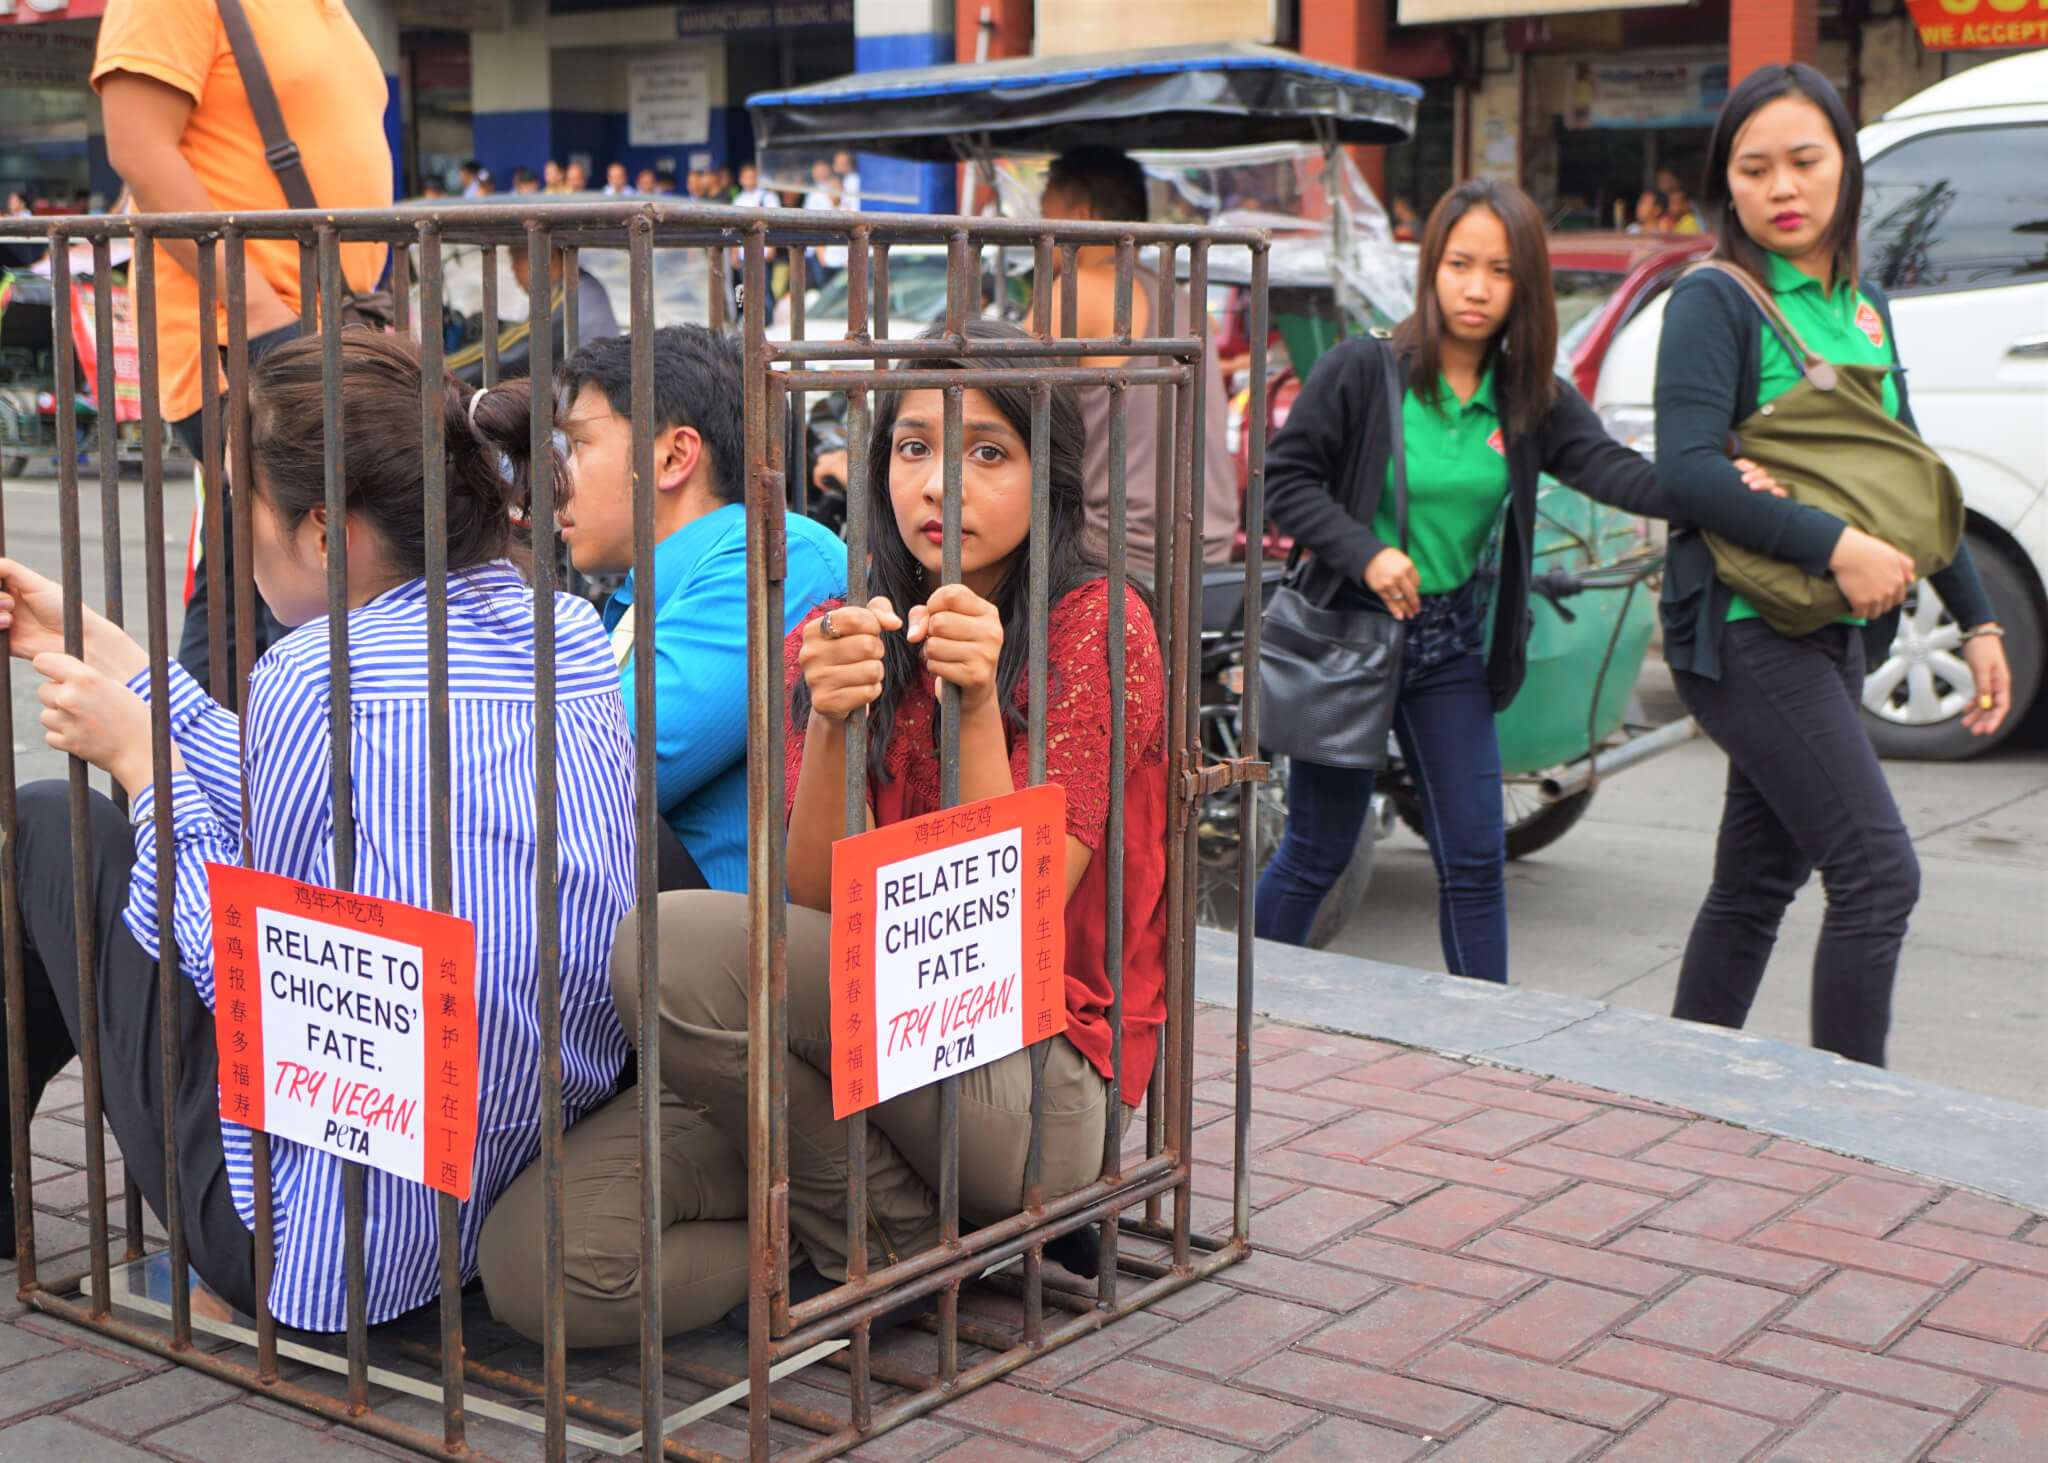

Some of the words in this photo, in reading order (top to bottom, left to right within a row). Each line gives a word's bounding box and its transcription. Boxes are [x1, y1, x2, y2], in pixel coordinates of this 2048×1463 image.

[1921, 25, 1955, 47] WE
[1961, 20, 2048, 43] ACCEPT
[914, 806, 991, 845] 鸡年不吃鸡
[293, 886, 384, 927] 鸡年不吃鸡
[884, 854, 979, 911] RELATE
[987, 845, 1019, 878] TO
[266, 925, 373, 980] RELATE
[382, 954, 420, 991] TO
[1036, 823, 1052, 1033] 纯素护生在丁酉
[845, 878, 863, 1105] 金鸡报春多福寿
[917, 942, 986, 989] FATE.
[224, 903, 250, 1118] 金鸡报春多福寿
[887, 1000, 937, 1057] TRY
[940, 973, 1017, 1038] VEGAN.
[307, 1023, 383, 1072] FATE.
[440, 957, 459, 1188] 纯素护生在丁酉
[274, 1061, 328, 1108] TRY
[332, 1076, 418, 1140] VEGAN.
